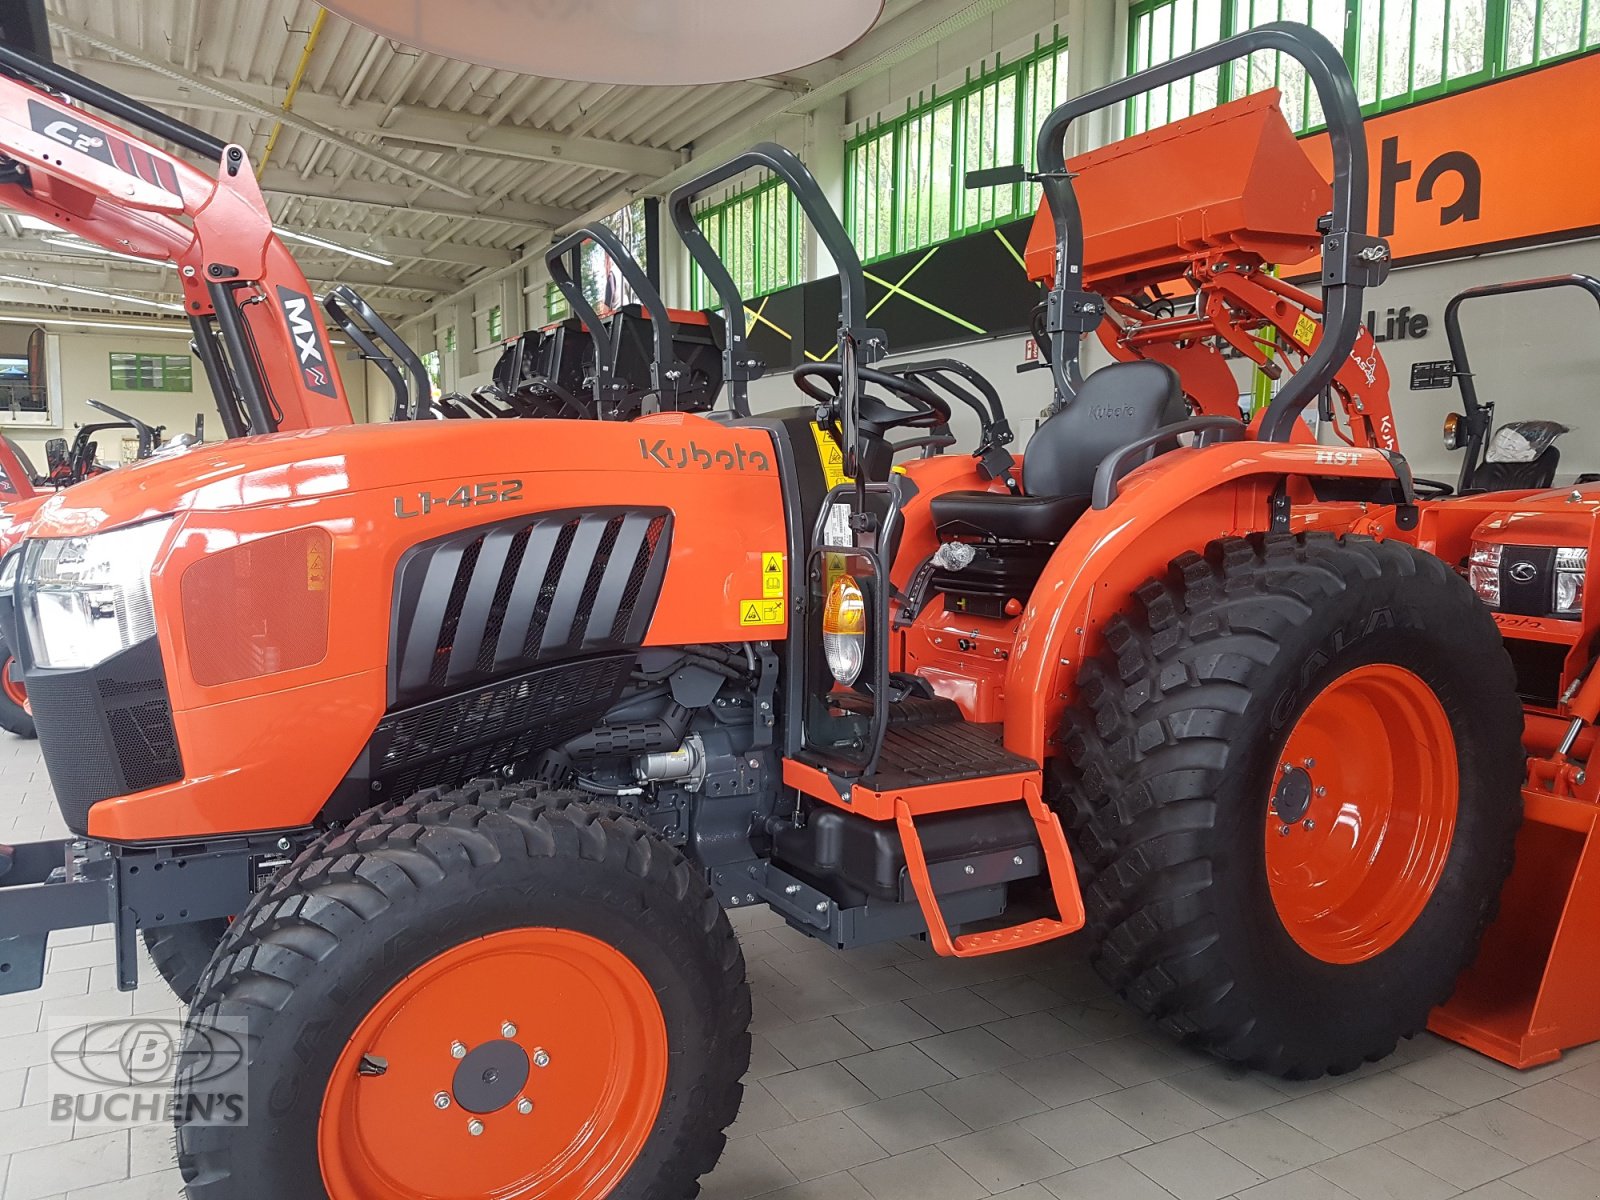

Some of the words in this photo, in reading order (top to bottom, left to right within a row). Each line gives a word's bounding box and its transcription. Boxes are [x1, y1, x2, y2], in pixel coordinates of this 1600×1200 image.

[1378, 135, 1482, 238] ta
[284, 297, 322, 365] MX
[1367, 306, 1429, 342] Life
[1088, 403, 1135, 420] Kubota
[1381, 415, 1394, 450] Kub
[638, 438, 769, 471] Kubota
[1314, 450, 1362, 467] HST
[394, 479, 523, 519] L1-452
[1494, 614, 1545, 630] bota
